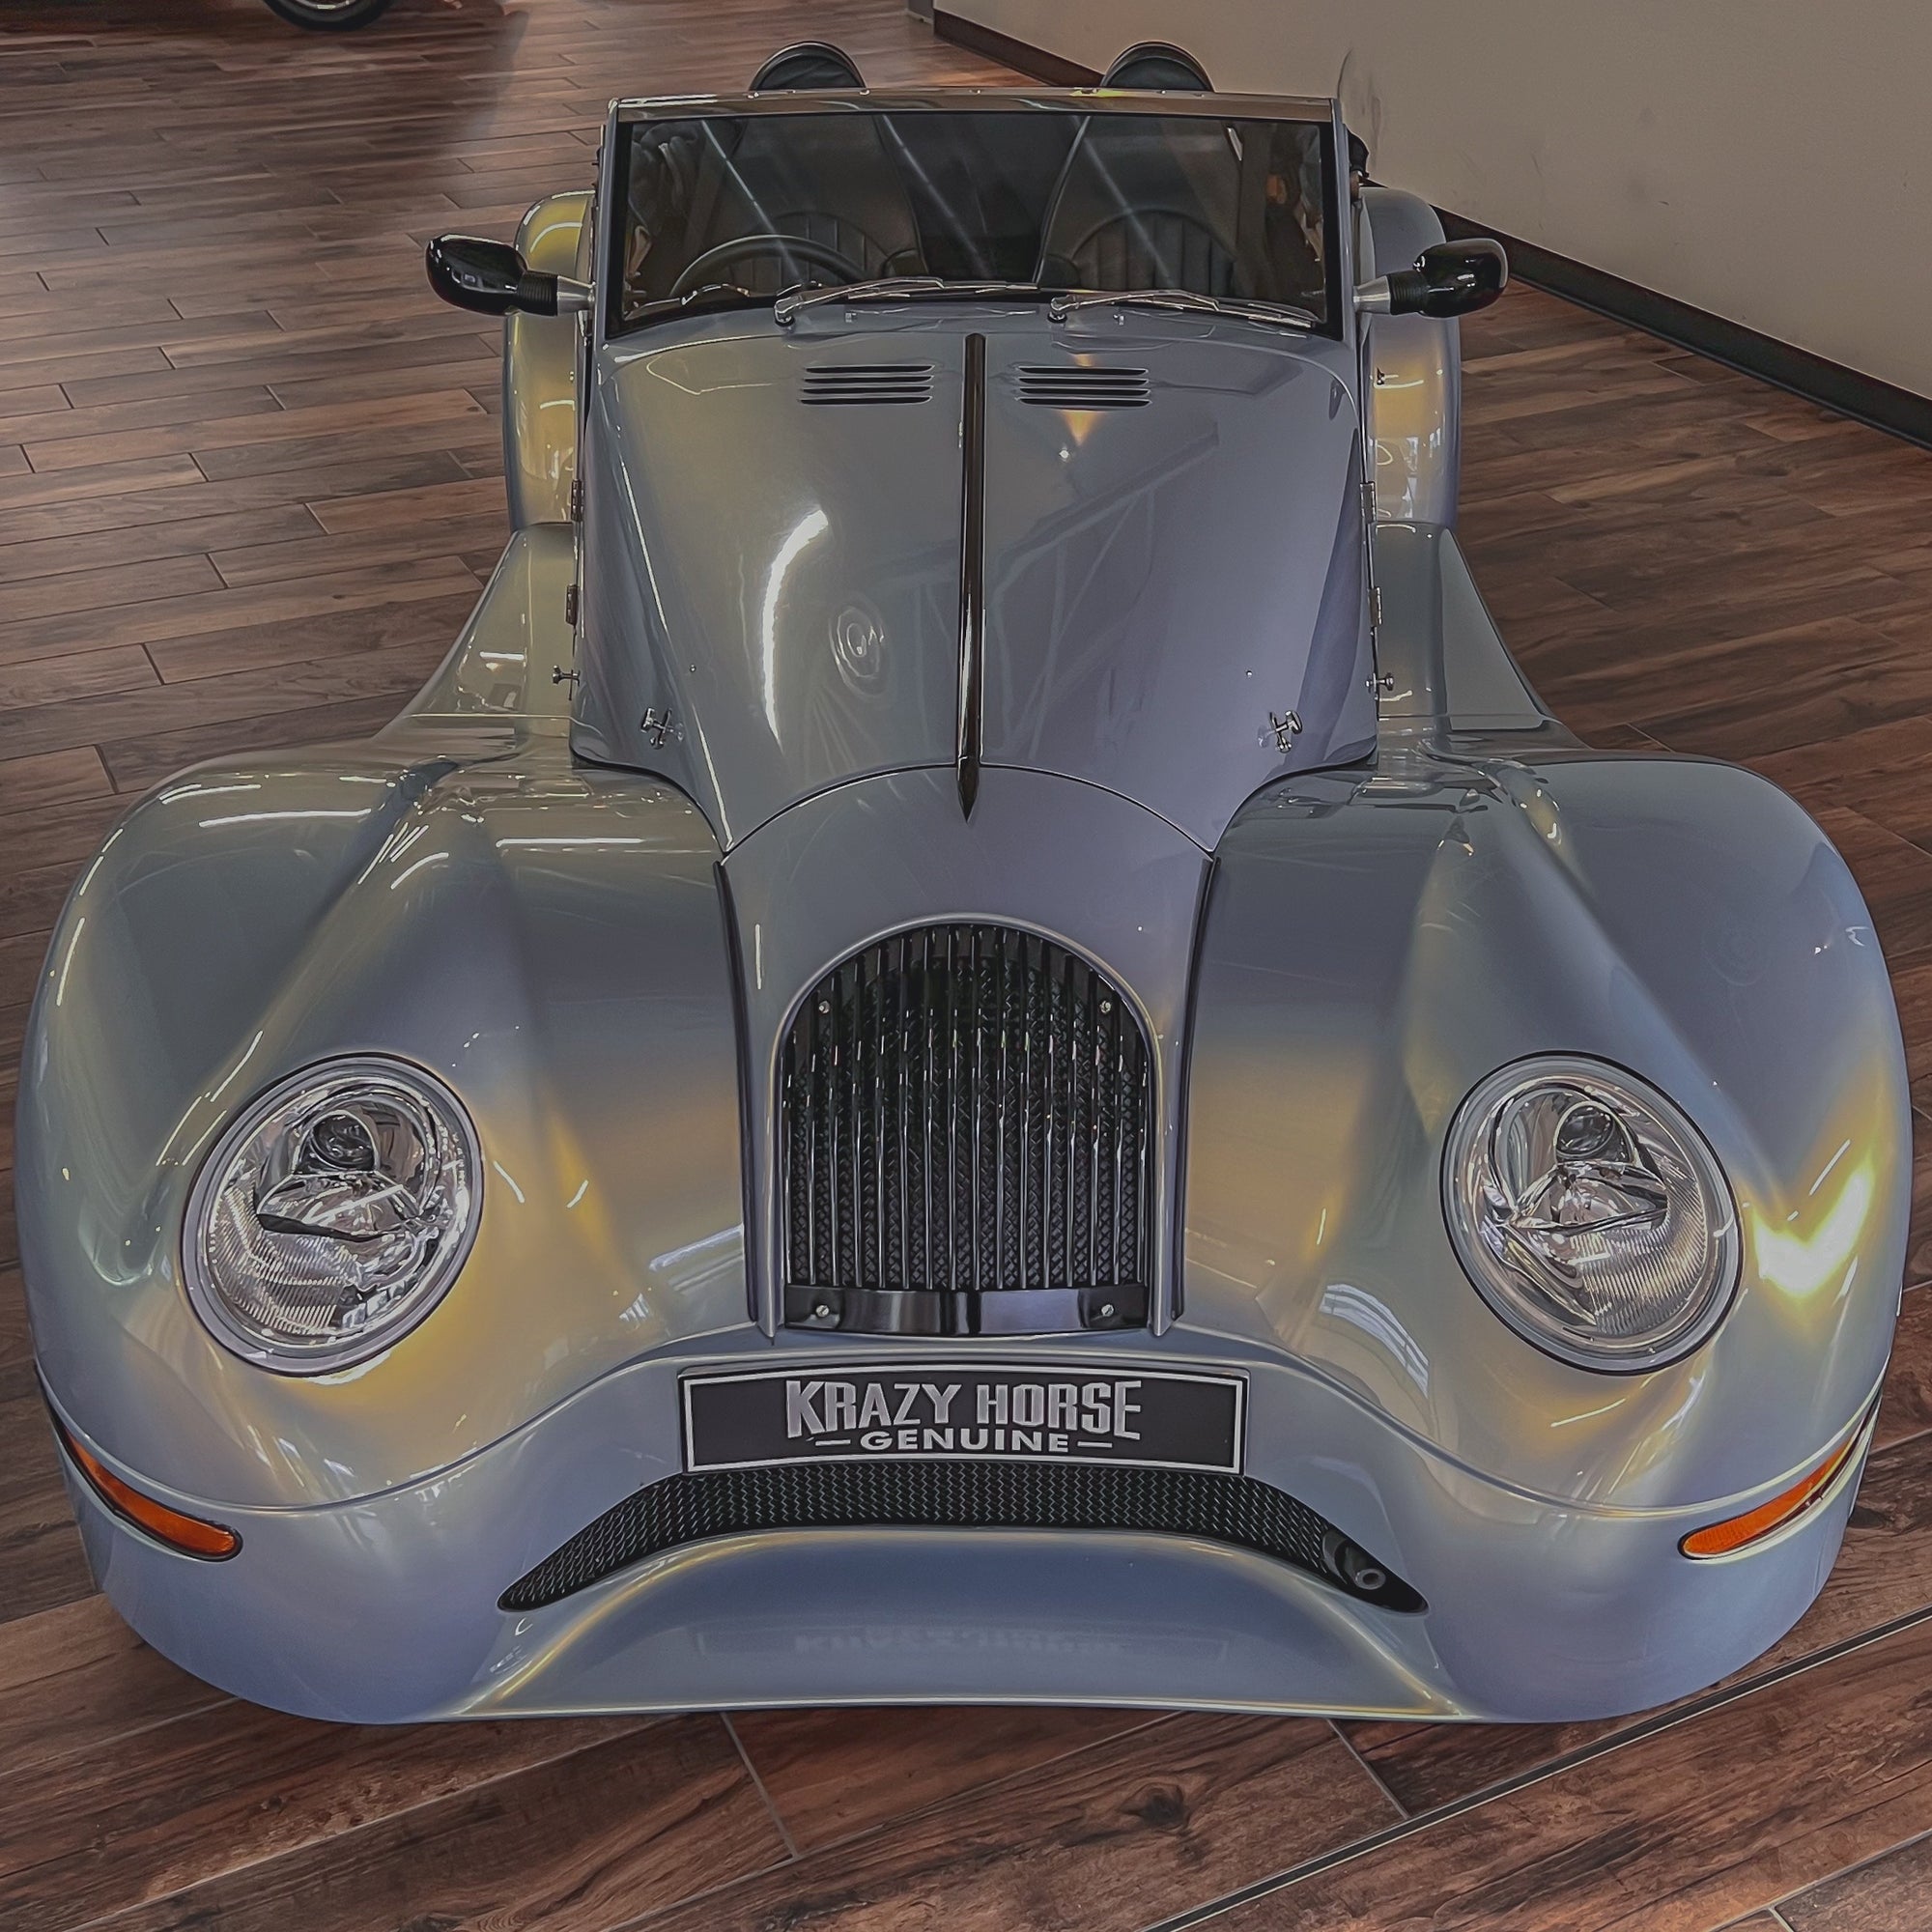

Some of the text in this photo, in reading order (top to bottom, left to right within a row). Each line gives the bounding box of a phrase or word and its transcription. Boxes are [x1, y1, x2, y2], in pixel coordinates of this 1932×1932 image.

[786, 1379, 1142, 1440] KRAZY HORSE
[860, 1429, 1069, 1452] GENUINE
